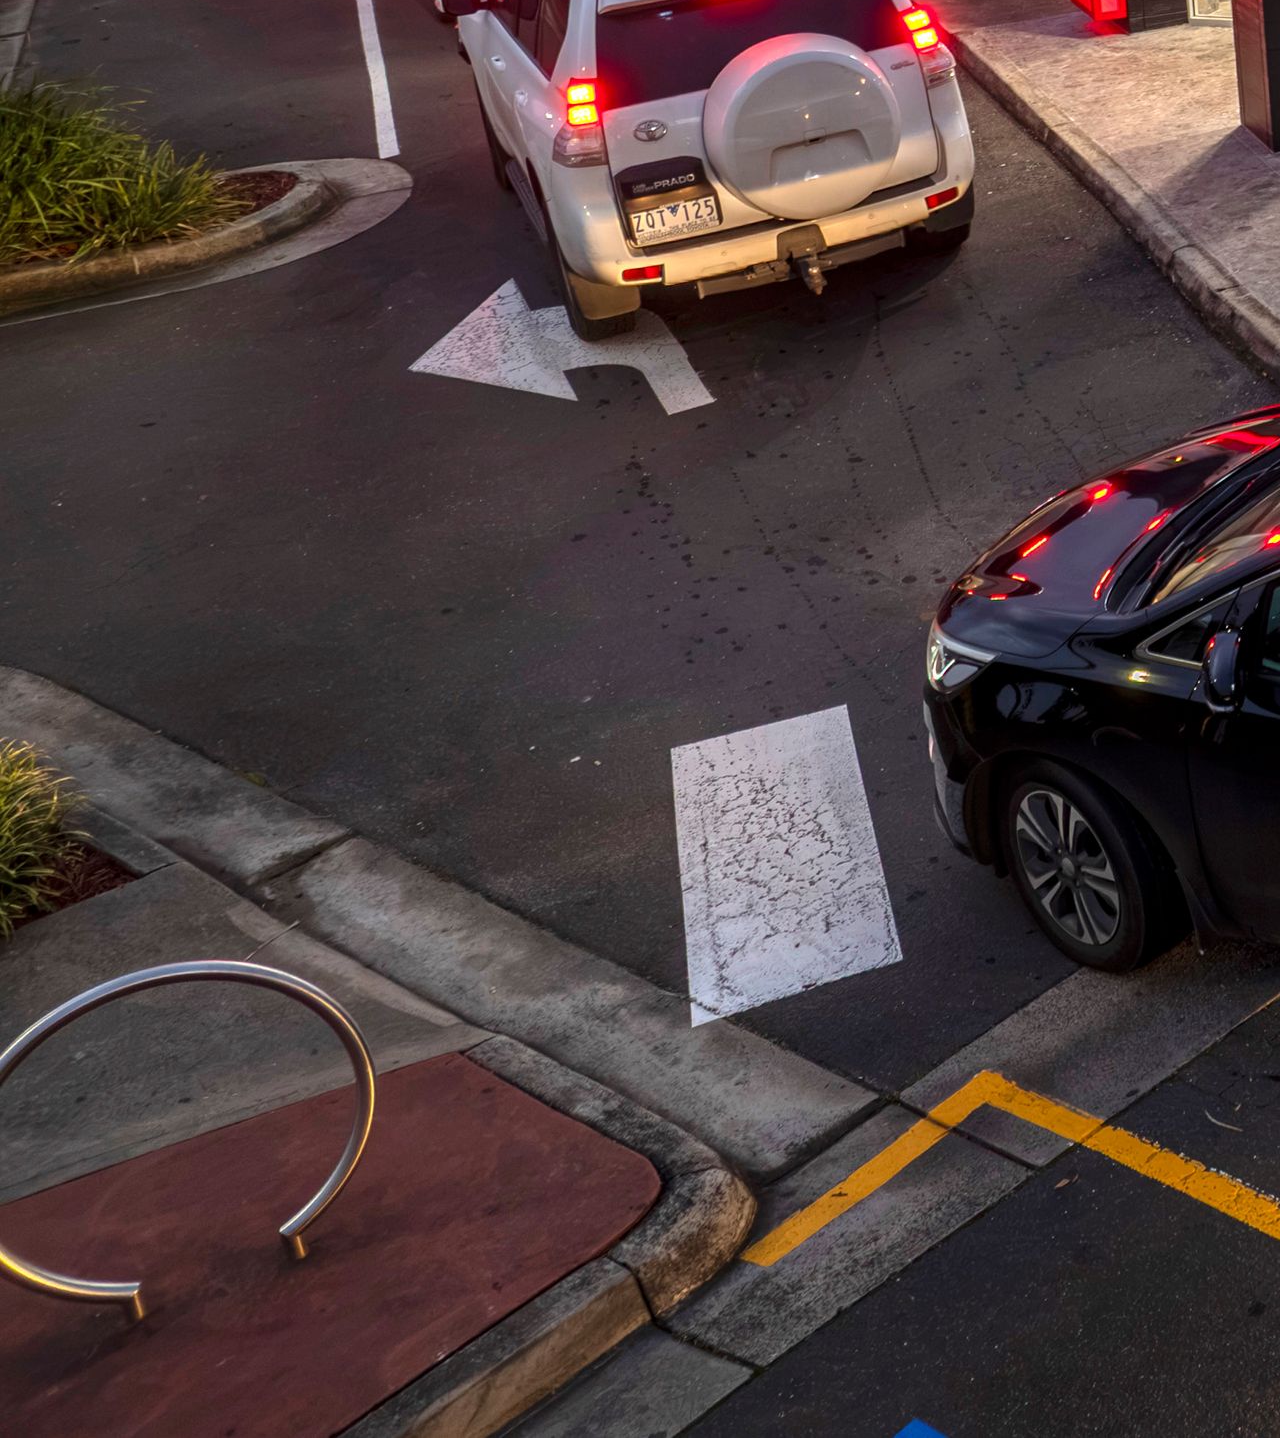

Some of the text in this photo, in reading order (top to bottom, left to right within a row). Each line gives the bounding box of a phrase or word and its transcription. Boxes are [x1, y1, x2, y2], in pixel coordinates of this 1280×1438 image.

[654, 173, 695, 189] PRADO
[633, 199, 715, 233] ZQT 125
